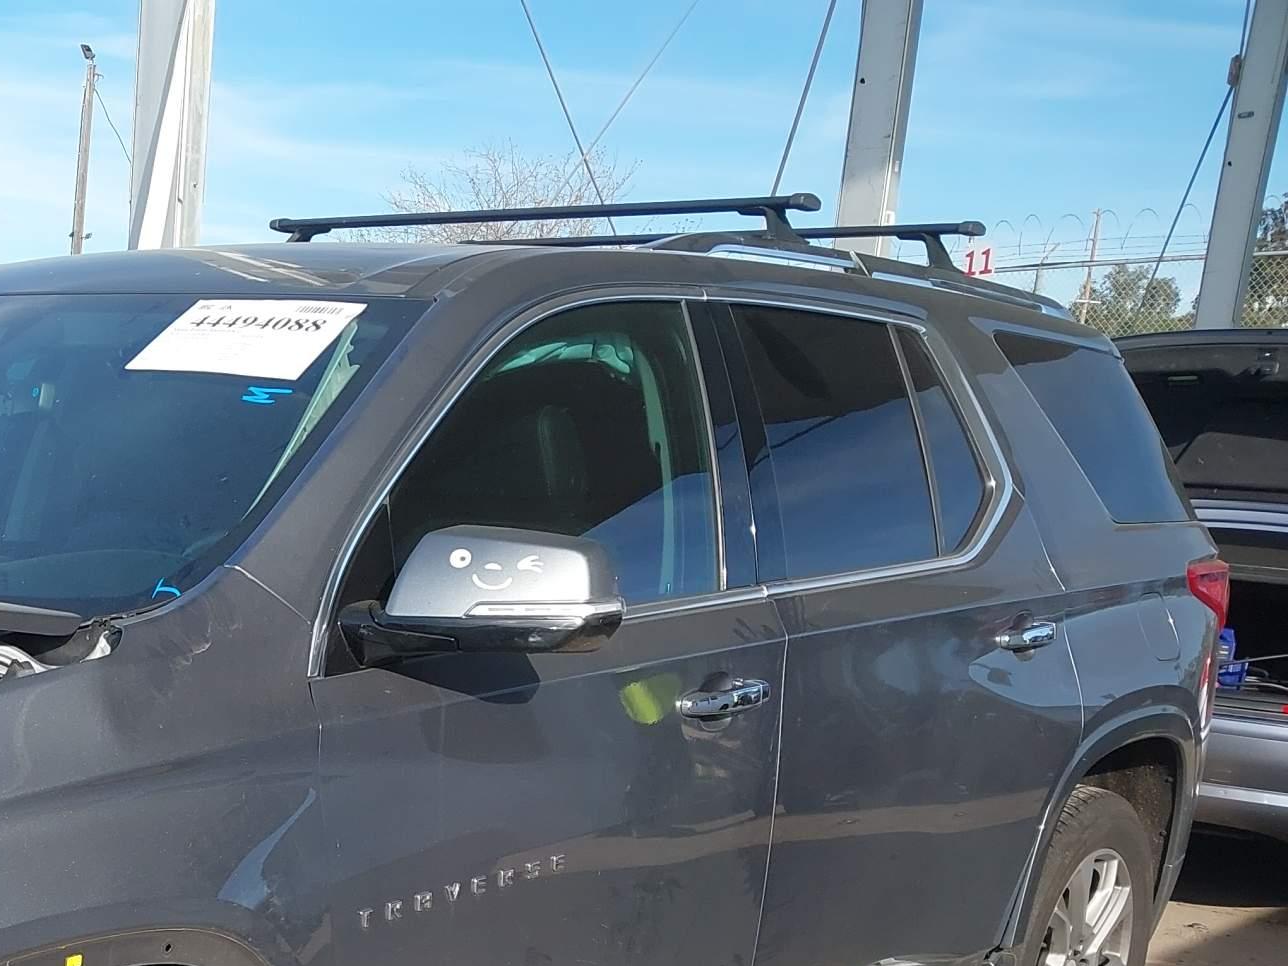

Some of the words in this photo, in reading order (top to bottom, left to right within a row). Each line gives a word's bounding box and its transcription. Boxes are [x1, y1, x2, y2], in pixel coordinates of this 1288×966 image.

[964, 247, 993, 276] 11
[189, 314, 328, 333] 44494088
[356, 853, 567, 930] TRAVERSE
